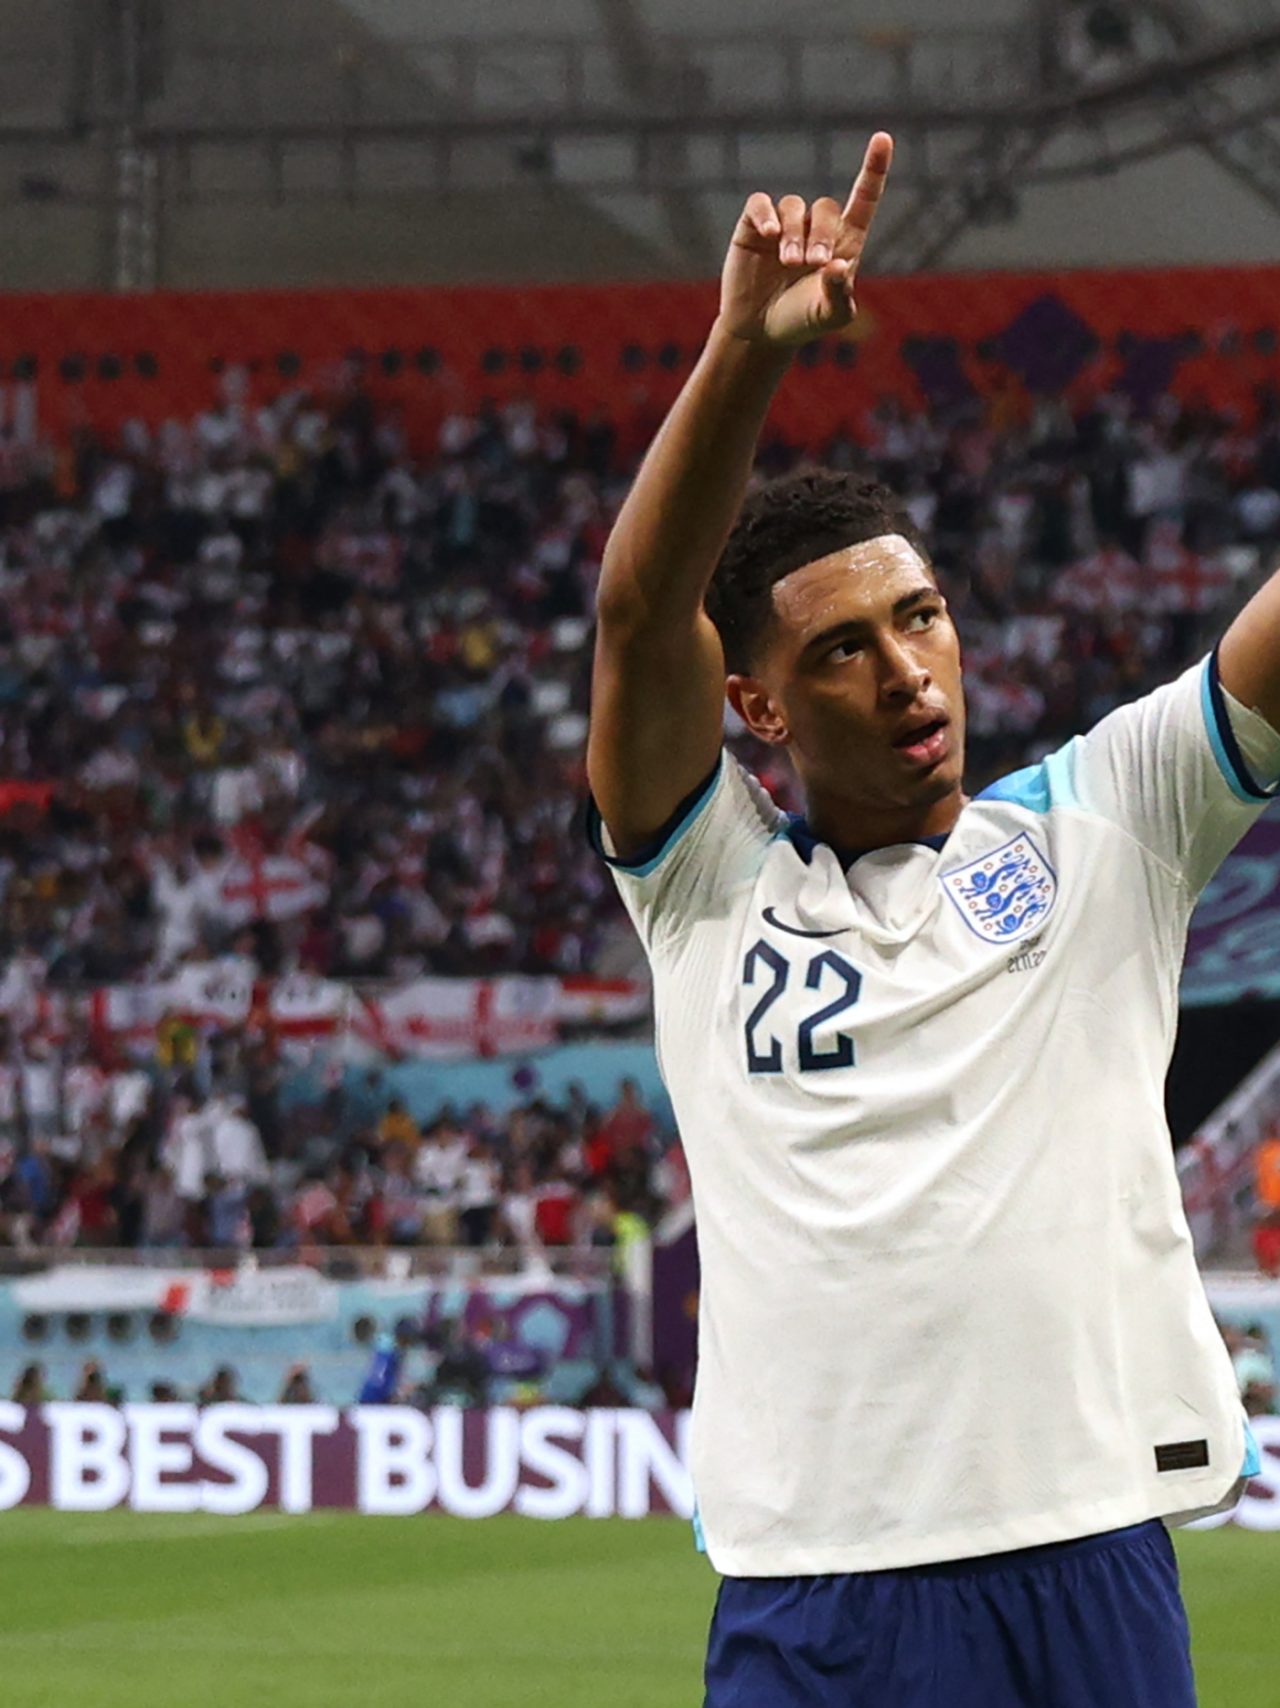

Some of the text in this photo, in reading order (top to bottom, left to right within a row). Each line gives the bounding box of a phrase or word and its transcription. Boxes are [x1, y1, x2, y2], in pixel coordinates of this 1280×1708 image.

[743, 938, 863, 1075] 22
[43, 1402, 340, 1514] BEST
[347, 1405, 695, 1519] BUSIN
